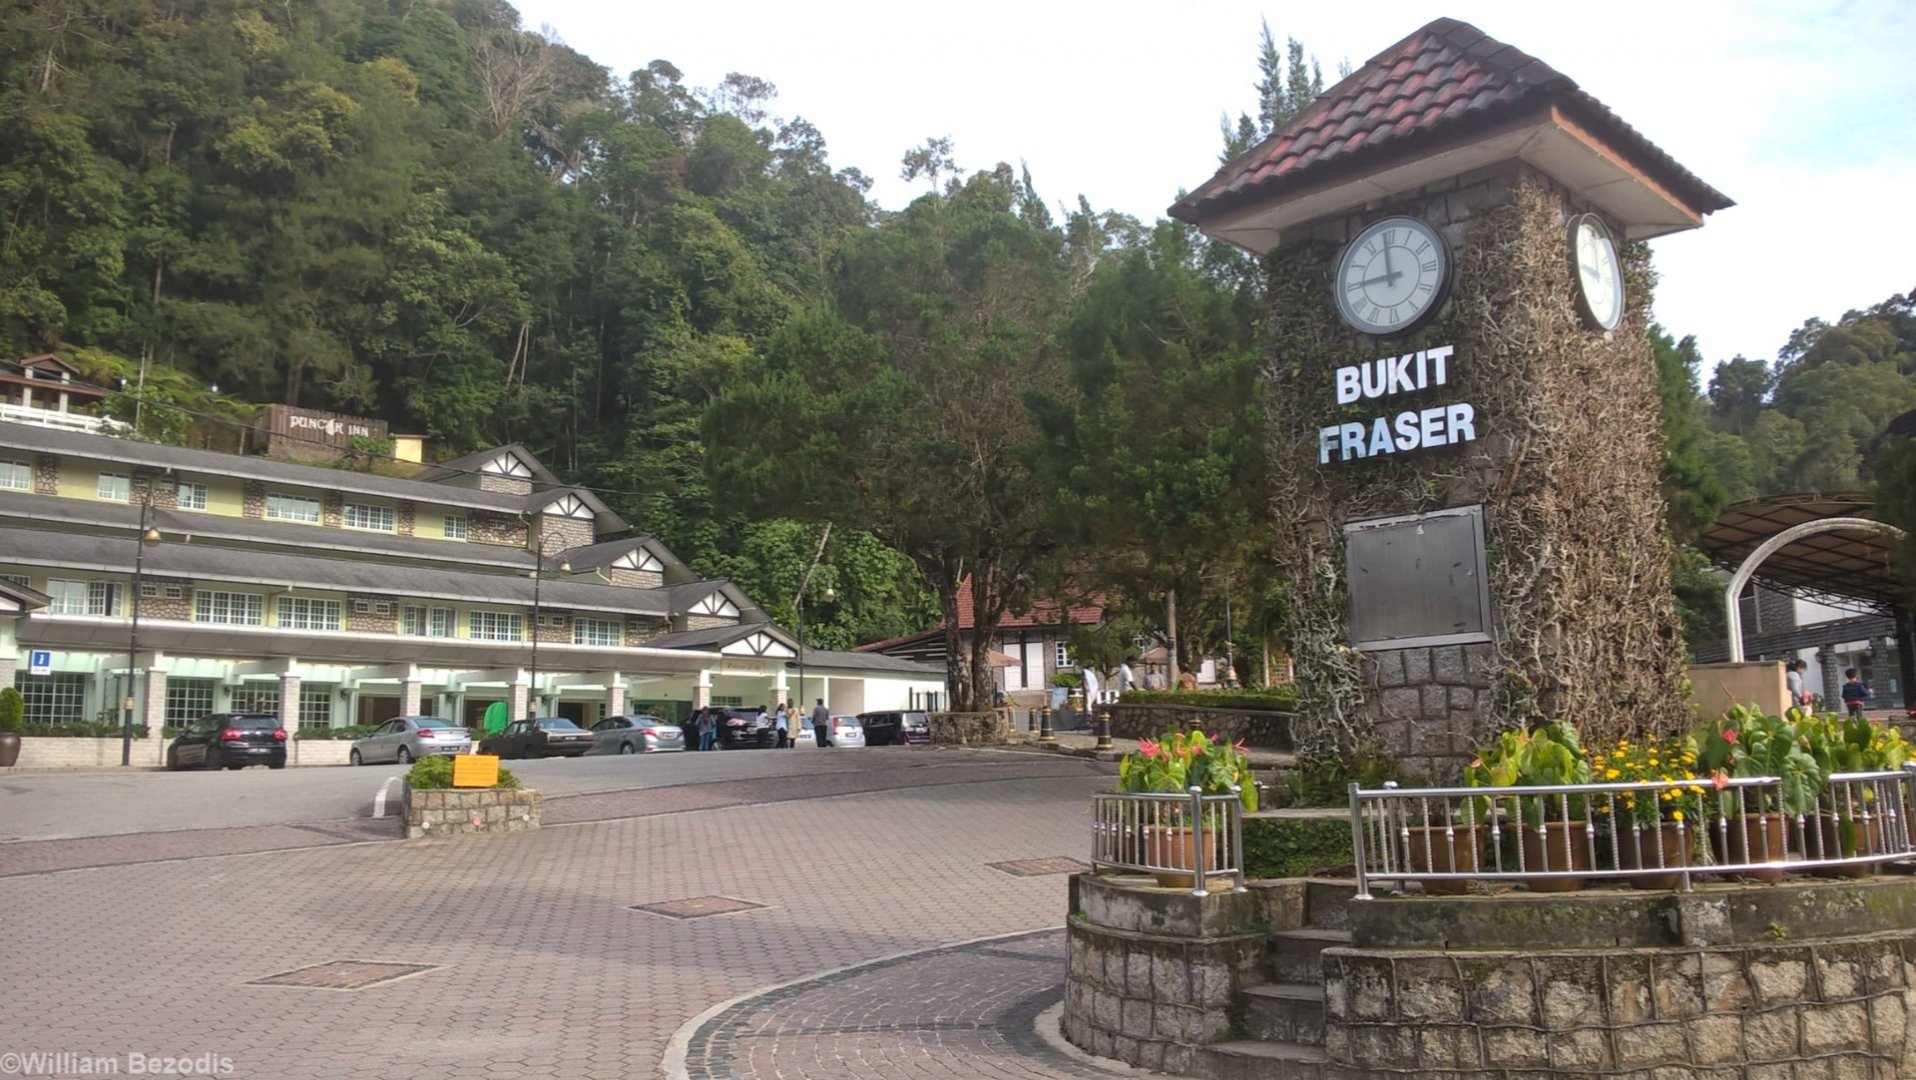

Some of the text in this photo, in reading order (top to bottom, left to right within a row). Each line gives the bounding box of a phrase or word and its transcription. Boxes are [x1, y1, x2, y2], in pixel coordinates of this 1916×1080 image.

[1422, 259, 1436, 272] III
[1336, 345, 1454, 405] BUKIT
[348, 425, 369, 437] INN
[1319, 403, 1476, 464] FRASER
